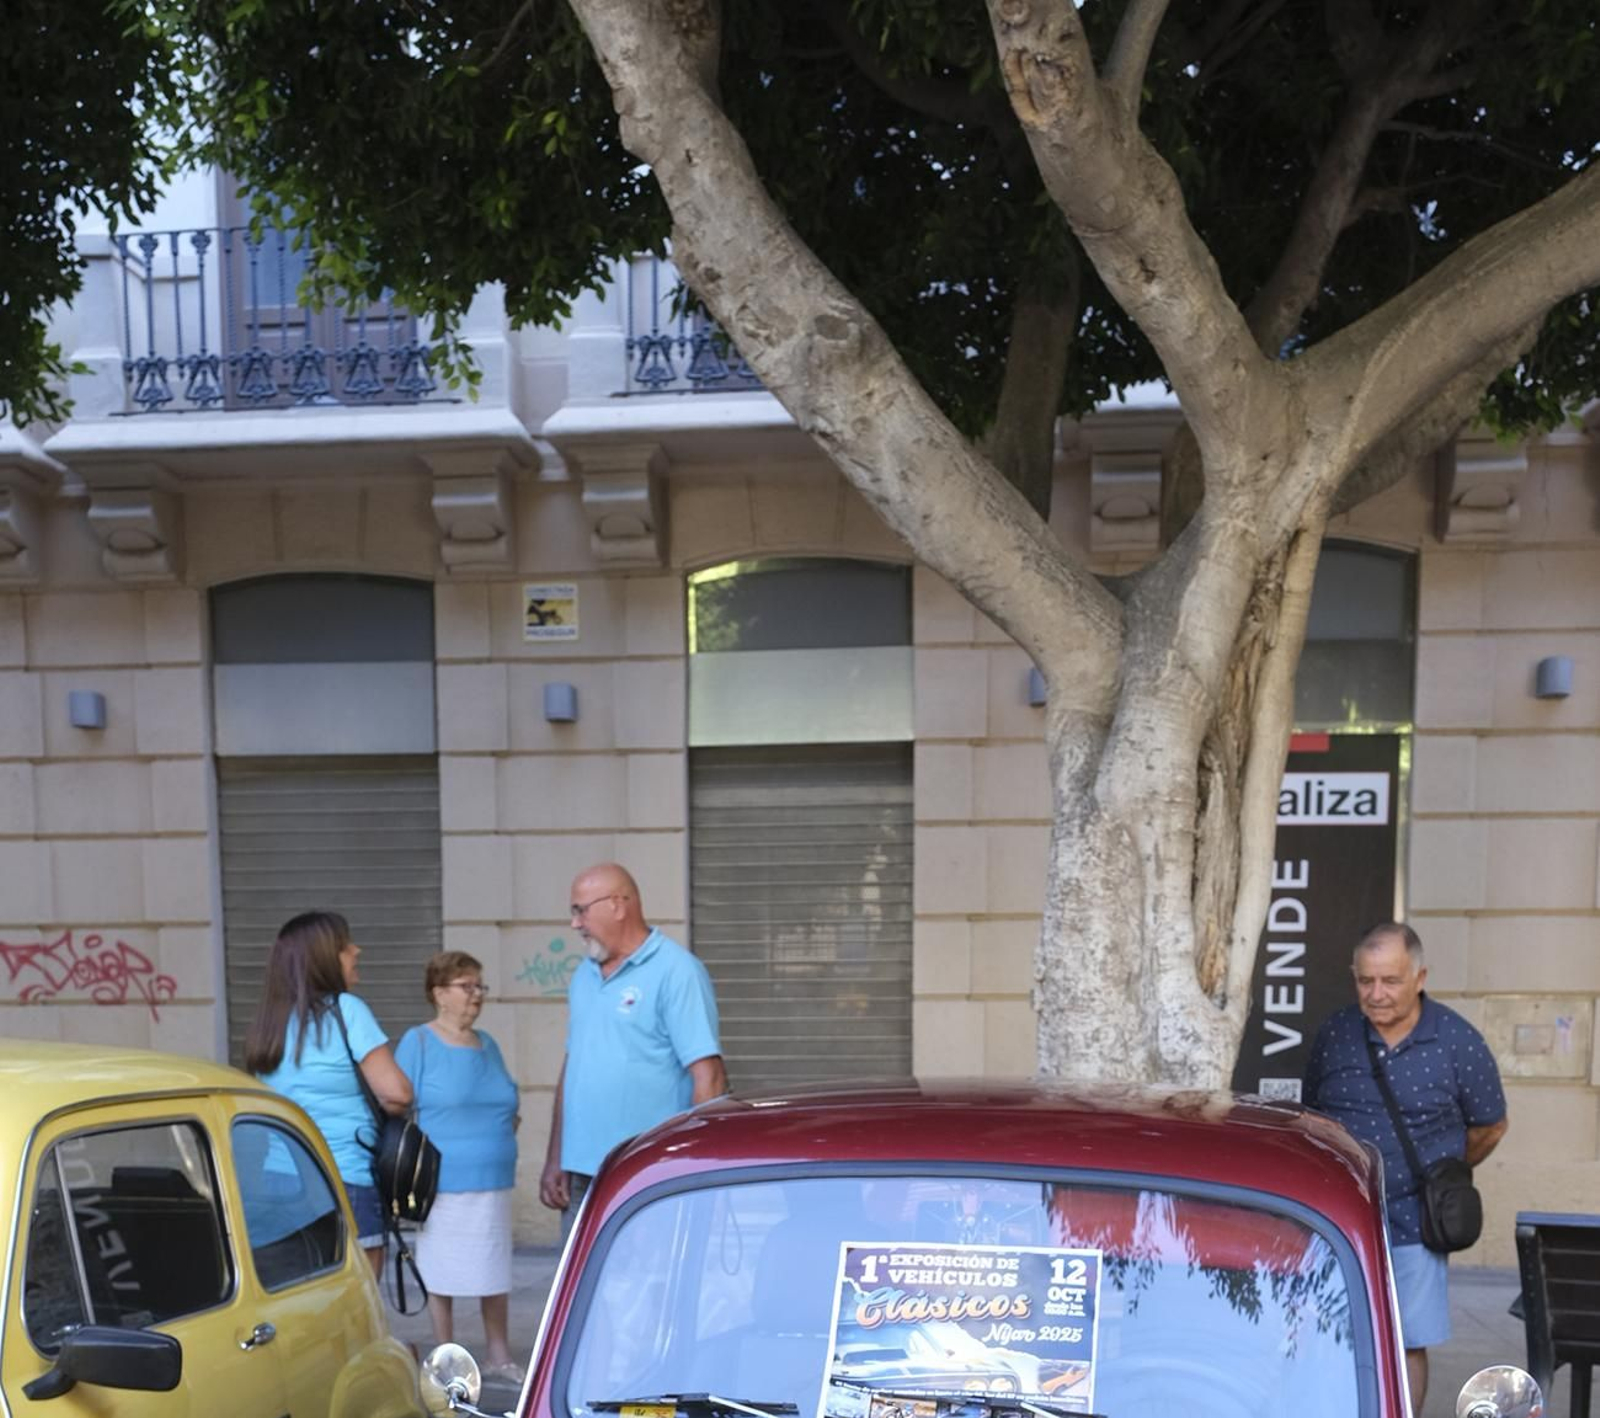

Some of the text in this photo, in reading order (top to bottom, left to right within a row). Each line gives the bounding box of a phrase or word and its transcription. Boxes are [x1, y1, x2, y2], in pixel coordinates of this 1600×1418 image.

[1262, 859, 1309, 1056] VENDE
[889, 1254, 993, 1270] EXPOSICIÓN
[996, 1258, 1020, 1270] DE
[888, 1268, 1018, 1287] VEHÍCULOS
[1050, 1258, 1087, 1286] 12
[1047, 1286, 1087, 1302] OCT
[854, 1287, 1032, 1329] Clásicos
[1037, 1326, 1083, 1343] 2025
